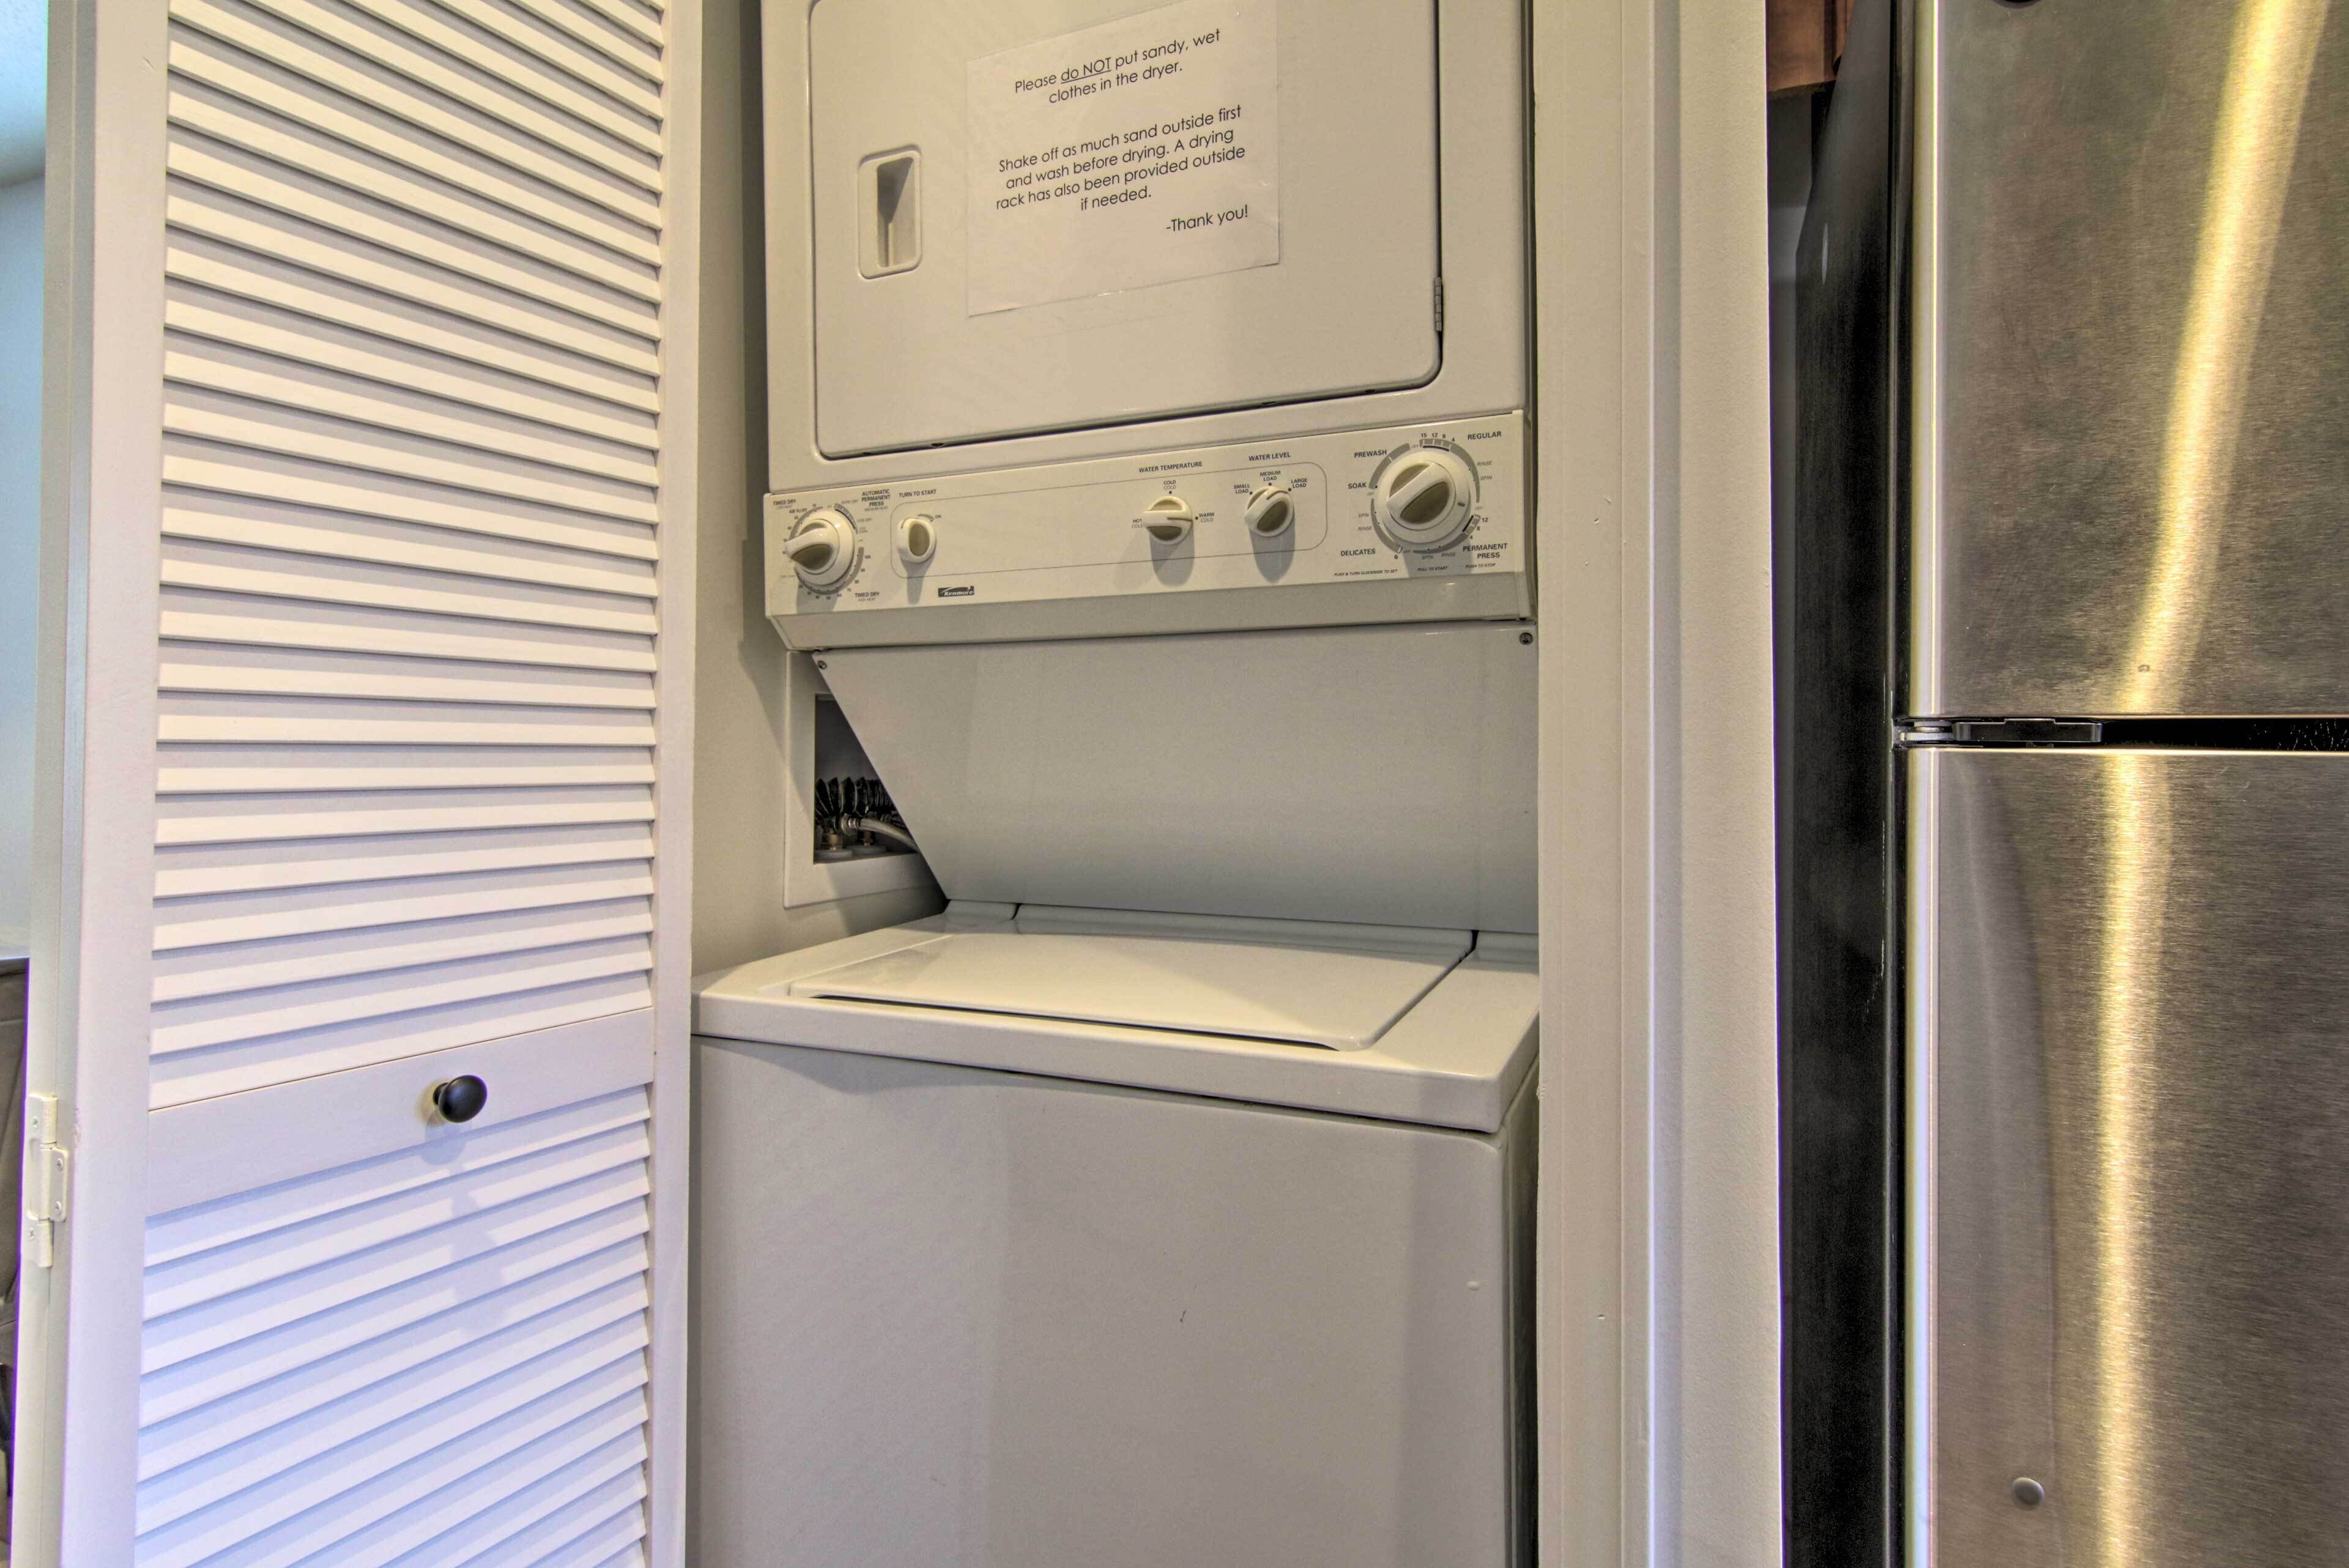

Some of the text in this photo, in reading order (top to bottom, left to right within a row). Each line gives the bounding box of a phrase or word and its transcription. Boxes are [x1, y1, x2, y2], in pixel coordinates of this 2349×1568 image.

[1015, 29, 1221, 93] Please do NOT put sandy, wet
[1049, 60, 1182, 104] clothes in the dryer.
[999, 105, 1242, 173] Shake off as much sand outside first
[1006, 129, 1234, 189] and wash before drying. A drying
[996, 146, 1245, 210] rack has also been provided outside
[1080, 185, 1152, 210] if needed.
[1166, 205, 1249, 232] -Thank you!
[1468, 431, 1502, 440] REGULAR
[1354, 449, 1387, 458] PREWASH
[1138, 461, 1203, 474] WATER TEMPERATURE
[1340, 548, 1376, 557] DELICATES
[1463, 543, 1508, 552] PERMANENT
